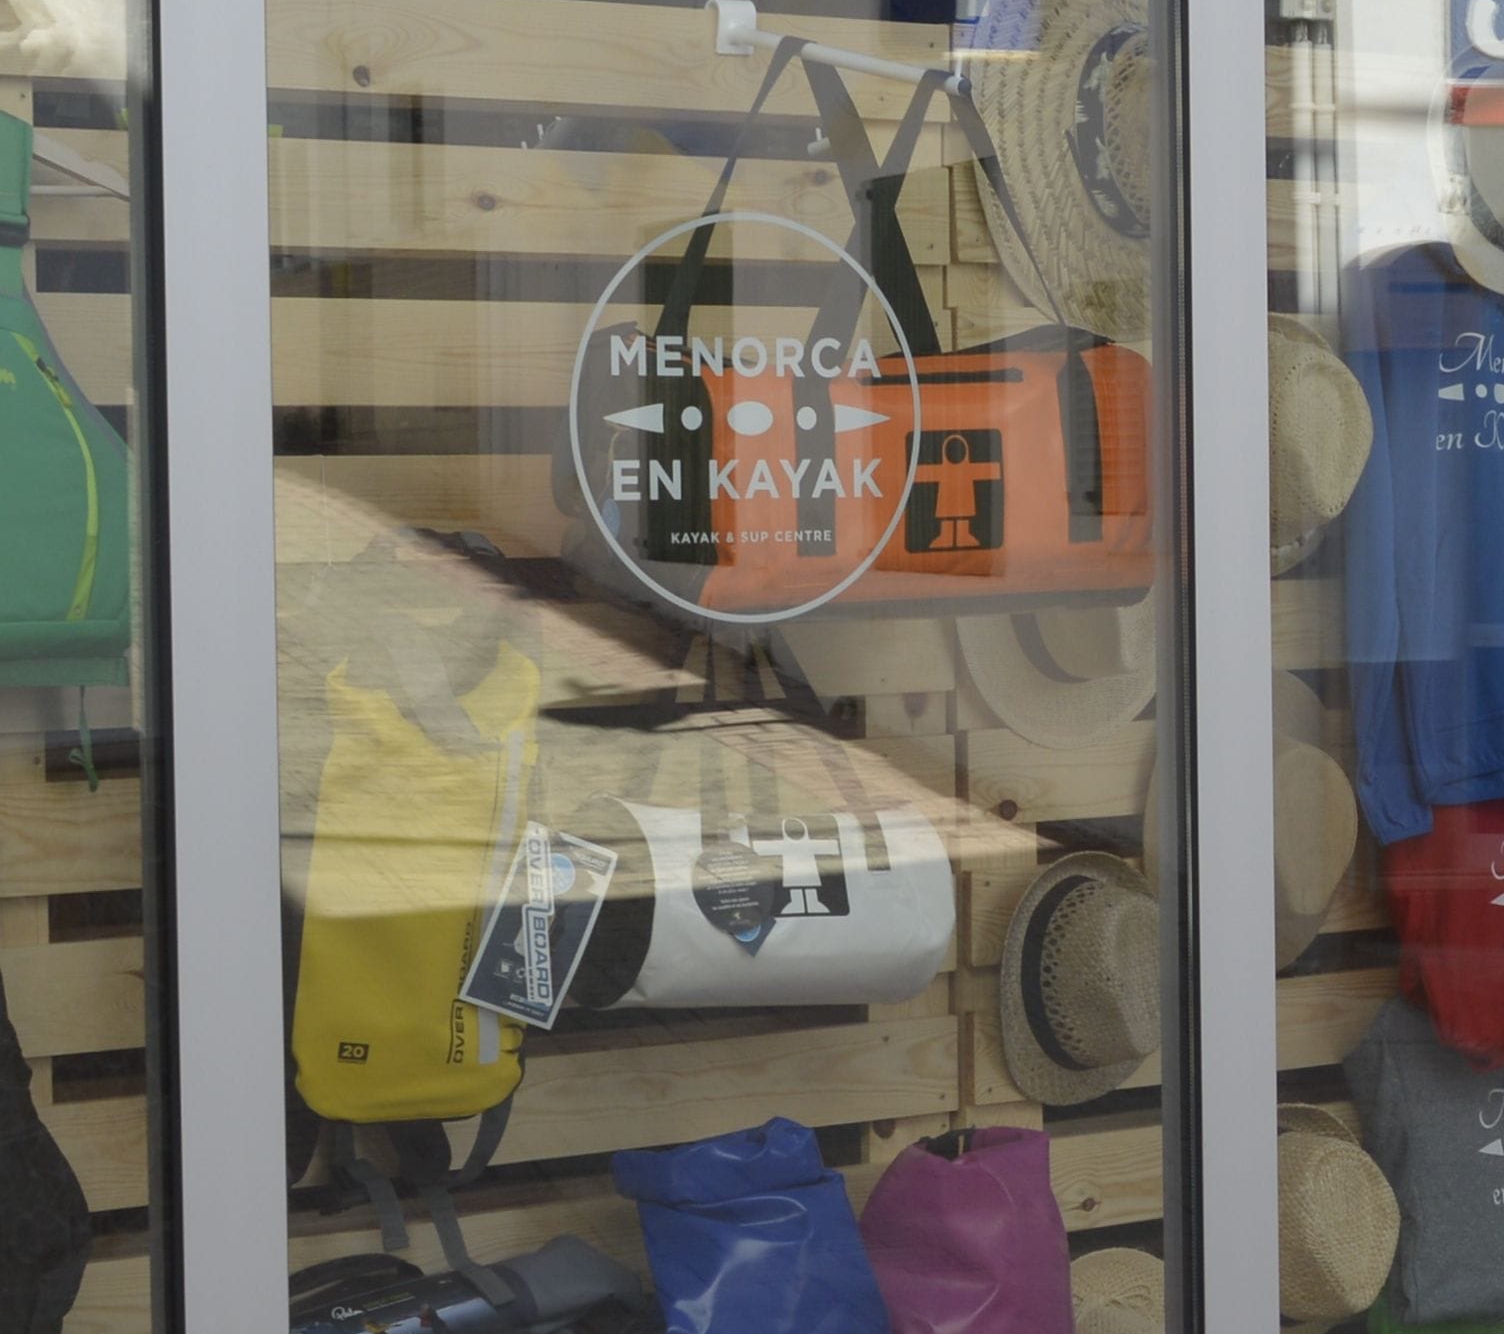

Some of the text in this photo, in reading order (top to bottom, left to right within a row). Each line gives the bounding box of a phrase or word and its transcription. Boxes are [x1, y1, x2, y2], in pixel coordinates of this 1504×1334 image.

[610, 335, 881, 378] MENORCA
[1436, 433, 1464, 451] en
[613, 458, 884, 501] EN KAYAK
[671, 529, 832, 544] KAYAK & SUP CENTRE
[527, 838, 551, 999] OVER BOARD
[342, 1044, 365, 1058] 20
[453, 1006, 464, 1064] OVER
